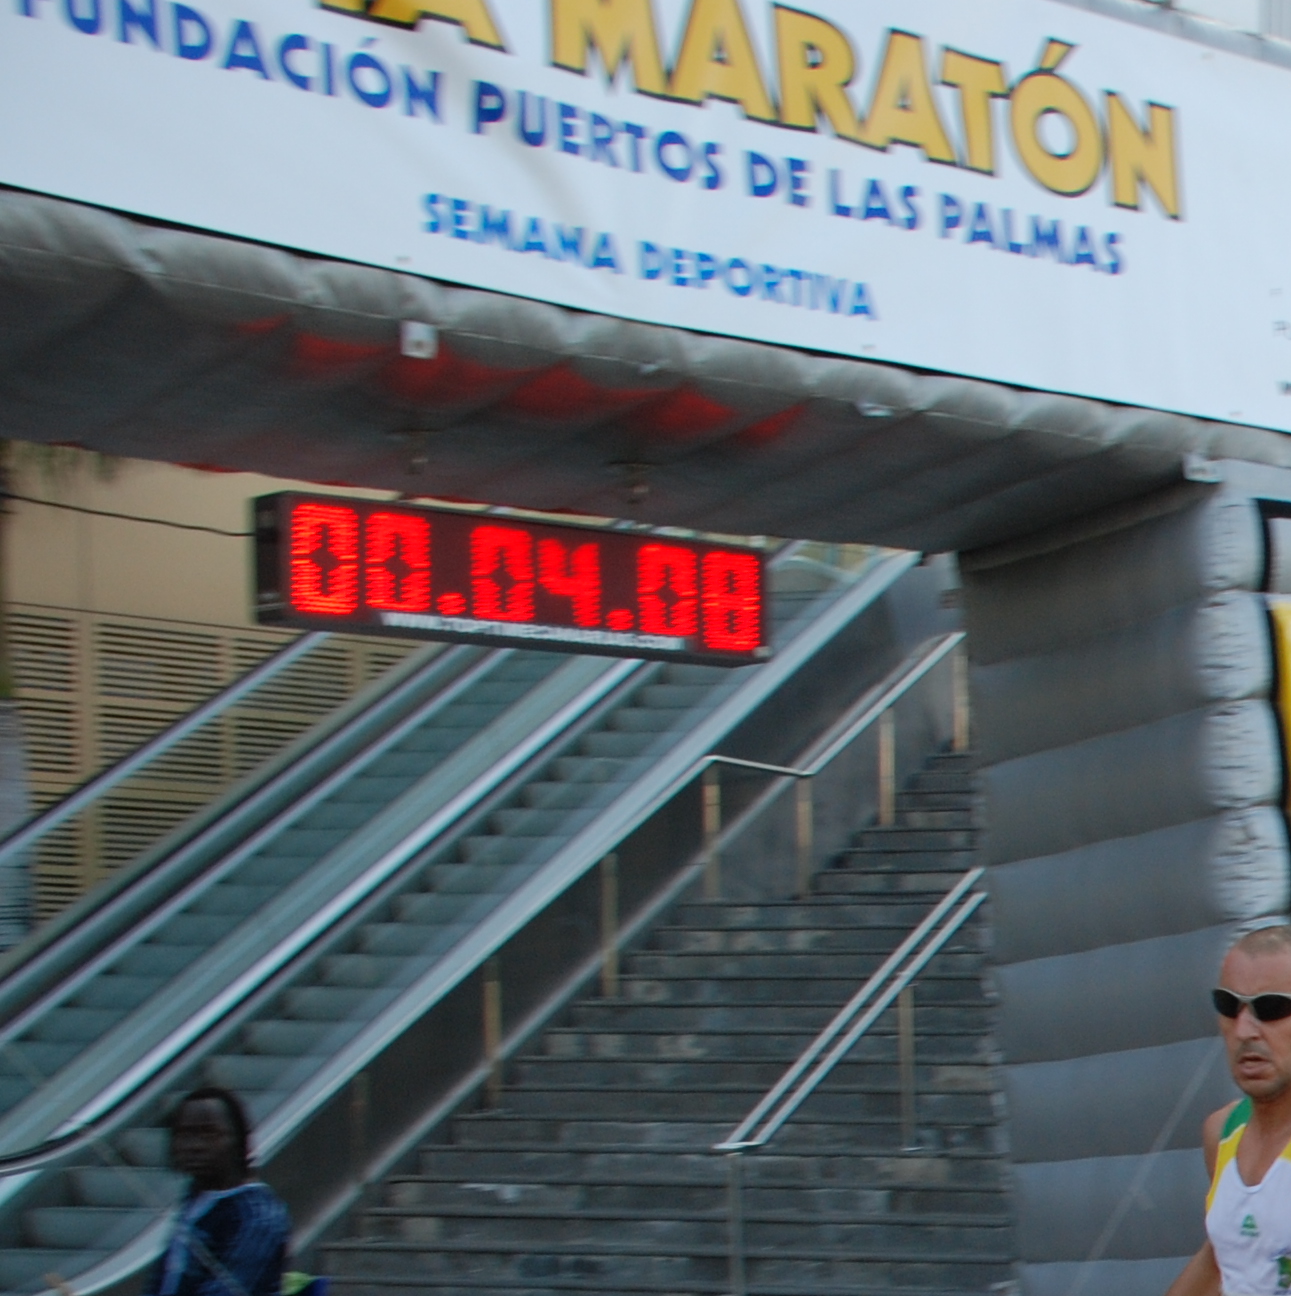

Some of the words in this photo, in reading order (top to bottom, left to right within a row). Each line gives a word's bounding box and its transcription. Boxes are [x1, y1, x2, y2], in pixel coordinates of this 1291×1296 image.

[469, 79, 725, 190] PUERTOS
[745, 149, 813, 208] DE
[826, 167, 923, 231] LAS
[936, 192, 1128, 275] PALMAS
[547, 0, 1186, 222] MARATÓN
[420, 192, 624, 275] SEMANA
[636, 239, 879, 321] DEPORTIVA
